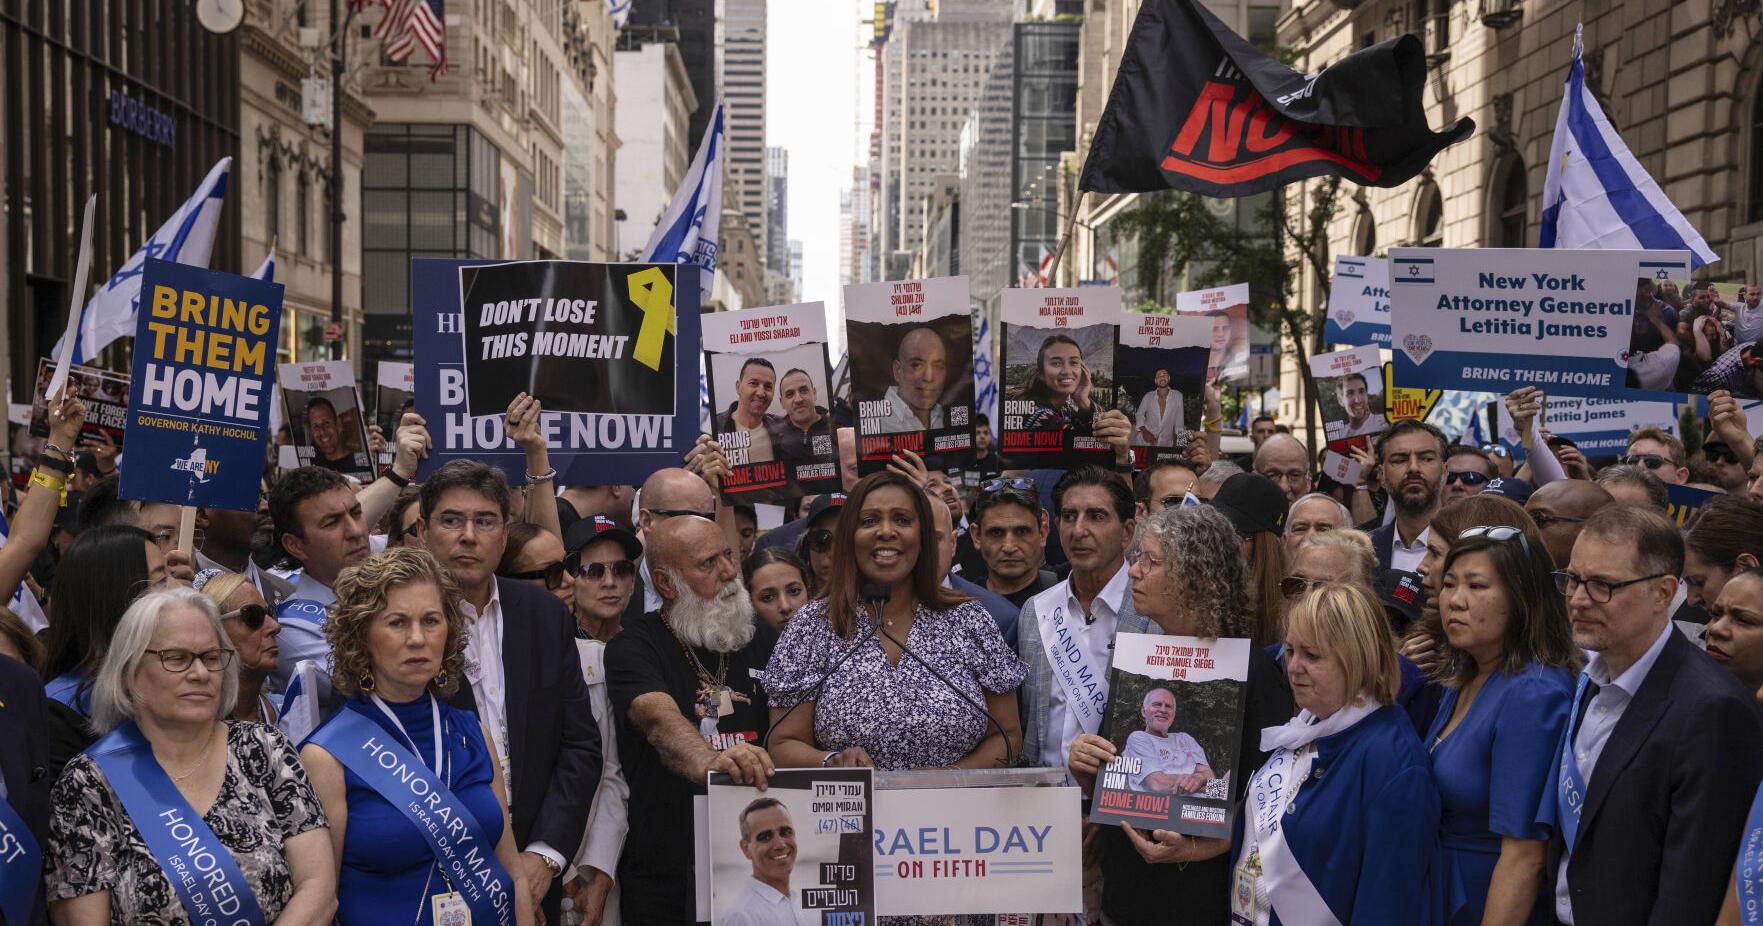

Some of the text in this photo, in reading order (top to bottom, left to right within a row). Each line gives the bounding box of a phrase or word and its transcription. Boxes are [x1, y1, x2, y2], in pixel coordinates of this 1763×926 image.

[1479, 273, 1585, 290] New York
[891, 292, 924, 305] SHLOMI ZIV
[1436, 294, 1632, 316] Attorney General
[151, 285, 270, 336] BRING
[480, 298, 542, 327] DON'T
[544, 298, 598, 324] LOSE
[1040, 306, 1083, 316] NOA ARGAMANI
[730, 327, 800, 344] ELI AND YOSSI SHARABI
[1139, 326, 1174, 336] ELIYA COHEN
[1460, 317, 1608, 340] Letitia James
[148, 322, 267, 376] THEM
[481, 332, 629, 360] THIS MOMENT
[1462, 366, 1611, 386] BRING THEM HOME
[142, 363, 262, 421] HOME
[80, 399, 128, 418] ON'T FORGE
[859, 400, 892, 418] BRING
[1004, 400, 1035, 414] BRING
[1392, 398, 1422, 416] NOW
[84, 411, 99, 424] EIR
[1004, 415, 1023, 430] HER
[1545, 410, 1625, 423] etitia James
[138, 416, 257, 441] GOVERNOR KATHY HOCHUL
[446, 412, 674, 450] HOE NOW!
[860, 418, 880, 435] HIM
[718, 430, 751, 450] BRING
[861, 436, 891, 454] HOME
[894, 432, 924, 451] NOW!
[1003, 431, 1063, 446] HOME NOW!
[1575, 440, 1598, 449] HEM
[176, 458, 220, 474] WE ARE NY
[725, 448, 750, 466] HEM
[754, 461, 785, 481] NOW!
[1054, 606, 1081, 663] GRAND
[1146, 656, 1215, 669] KEITH SAMUEL SIEGEL
[1050, 644, 1091, 718] ISRAEL DAY ON 5TH
[1172, 668, 1186, 679] (64)
[1103, 772, 1126, 790] HIM
[362, 738, 472, 844] HONORARY
[816, 785, 861, 797] עמרי מירן
[812, 801, 863, 813] OMRI MIRAN
[1100, 790, 1171, 813] HOME NOW!
[1258, 793, 1266, 810] ON
[1268, 774, 1282, 835] CHAIR
[1181, 810, 1225, 822] FAMILIES FORUM
[819, 819, 838, 832] (47)
[975, 825, 1052, 854] DAY
[408, 802, 441, 838] ISRAEL
[438, 837, 456, 859] DAY
[452, 861, 466, 880] ON
[464, 879, 481, 902] 5TH
[159, 808, 240, 916] HONORED
[897, 859, 986, 879] ON FIFTH
[825, 865, 855, 883] פדיון
[1744, 867, 1754, 895] DAY
[168, 854, 197, 894] ISRAEL
[192, 892, 213, 916] DAY
[807, 889, 858, 907] השבויים
[1747, 899, 1758, 922] ON
